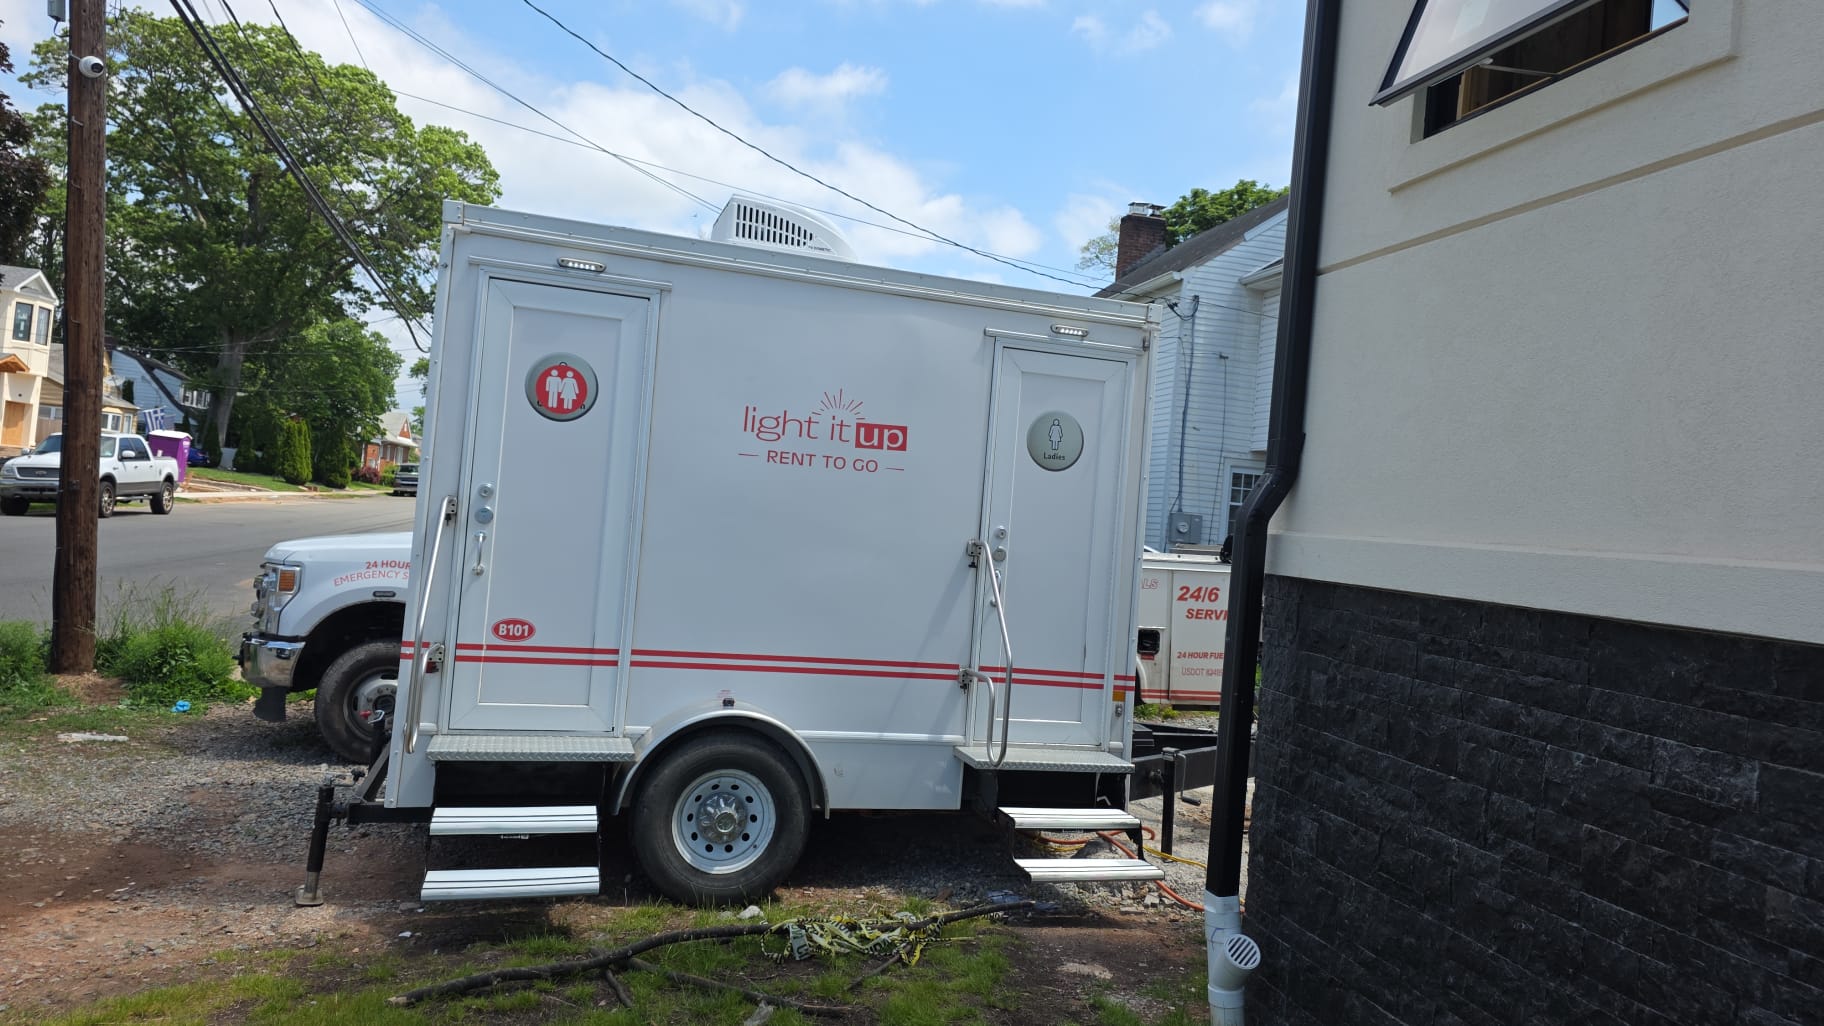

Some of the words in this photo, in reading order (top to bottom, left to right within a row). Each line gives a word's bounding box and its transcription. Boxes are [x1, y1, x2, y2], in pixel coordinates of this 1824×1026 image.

[743, 405, 820, 442] light
[830, 415, 851, 443] it
[858, 425, 905, 451] up
[766, 450, 817, 468] RENT
[822, 455, 847, 470] TO
[852, 458, 879, 473] GO
[1043, 451, 1066, 461] Ladies
[366, 560, 378, 569] 24
[333, 570, 400, 587] EMERGENCY
[1177, 585, 1220, 603] 24/6
[498, 623, 529, 637] B101
[1176, 651, 1187, 659] 24
[1187, 651, 1209, 659] HOUR
